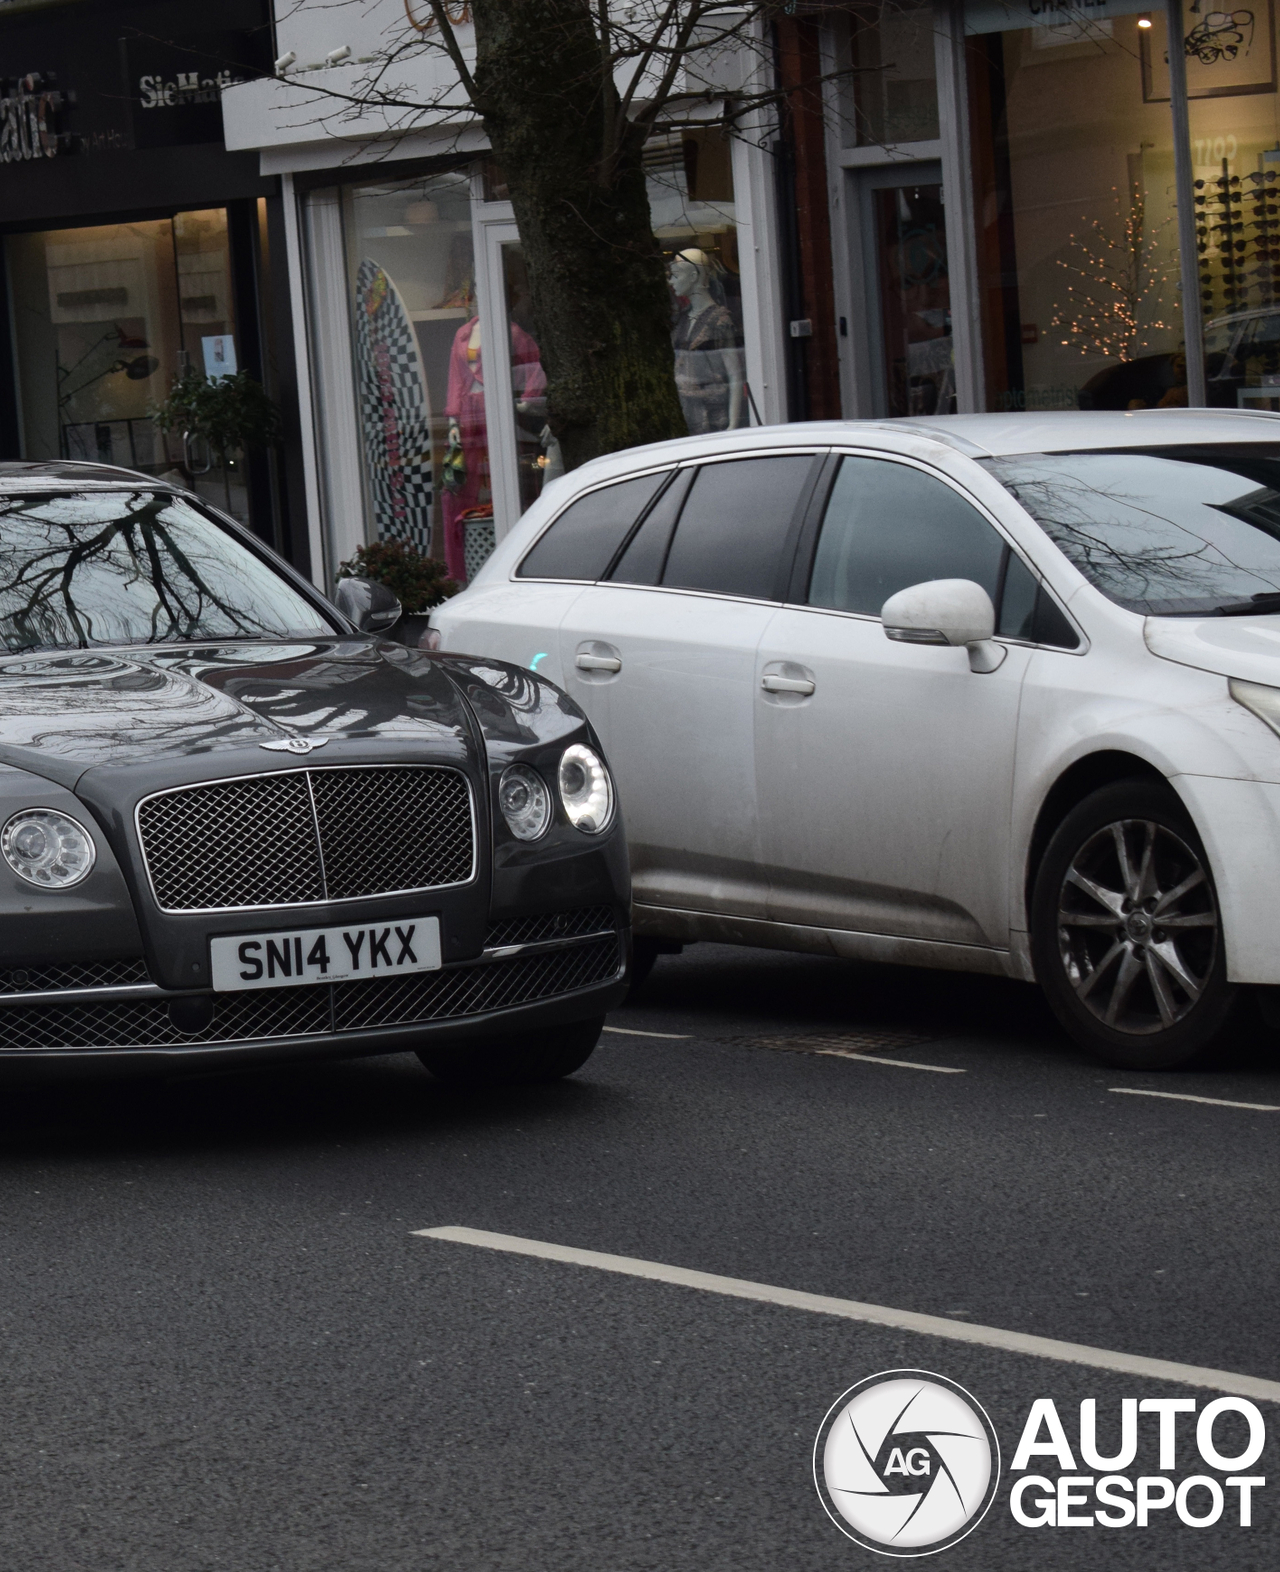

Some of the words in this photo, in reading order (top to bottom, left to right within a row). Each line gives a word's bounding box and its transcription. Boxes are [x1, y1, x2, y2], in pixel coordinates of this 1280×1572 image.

[382, 407, 402, 467] NOW
[238, 937, 331, 982] SN14
[342, 925, 419, 971] YKX
